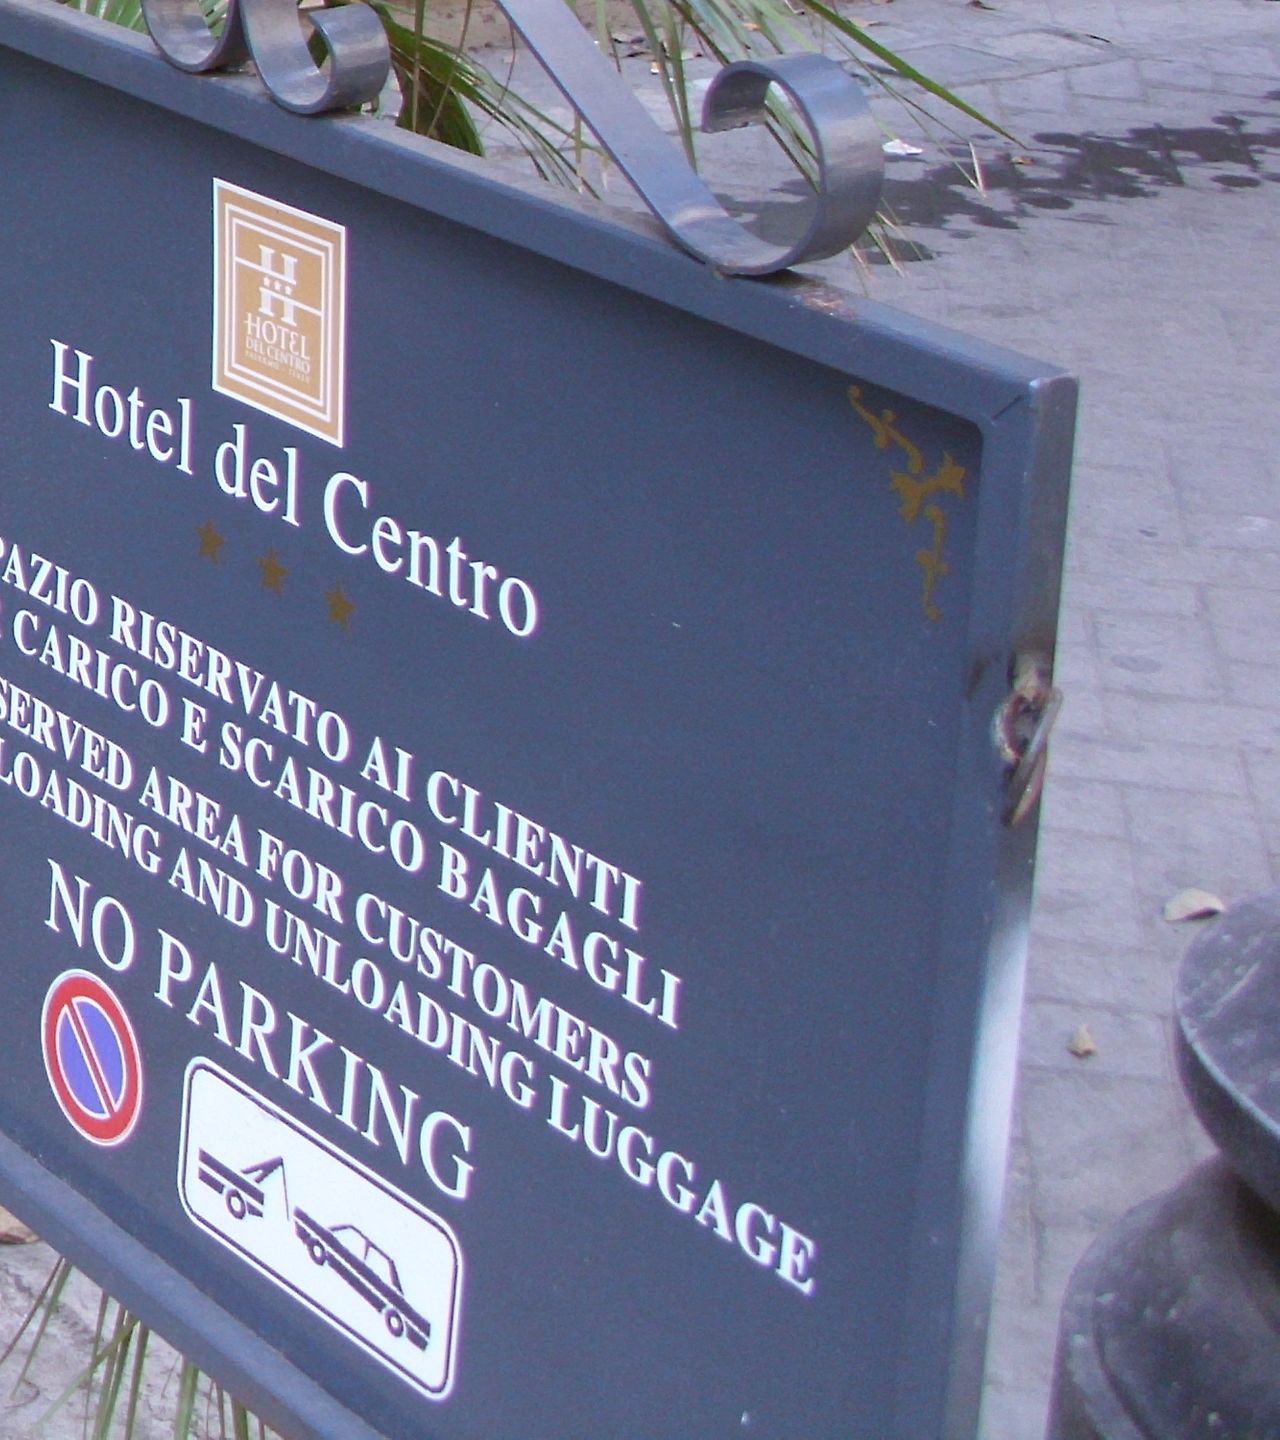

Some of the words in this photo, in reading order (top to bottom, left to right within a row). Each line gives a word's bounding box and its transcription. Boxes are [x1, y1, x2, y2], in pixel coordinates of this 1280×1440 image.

[48, 338, 194, 476] Hotel
[215, 423, 300, 527] del
[323, 472, 538, 637] Centro
[243, 311, 310, 360] HOTEL
[13, 609, 170, 728] CARICO
[180, 697, 208, 755] E
[219, 721, 425, 873] SCARICO
[436, 841, 682, 1030] BAGAGLI
[109, 595, 350, 763] RISERVATO
[359, 735, 414, 803] AI
[426, 770, 642, 932] CLIENTI
[43, 858, 136, 973] NO
[153, 928, 475, 1201] PARKING
[138, 766, 249, 867] AREA
[255, 828, 344, 925] FOR
[355, 892, 651, 1109] CUSTOMERS
[167, 846, 255, 929] AND
[264, 897, 537, 1110] UNLOADING
[546, 1074, 815, 1295] LUGGAGE
